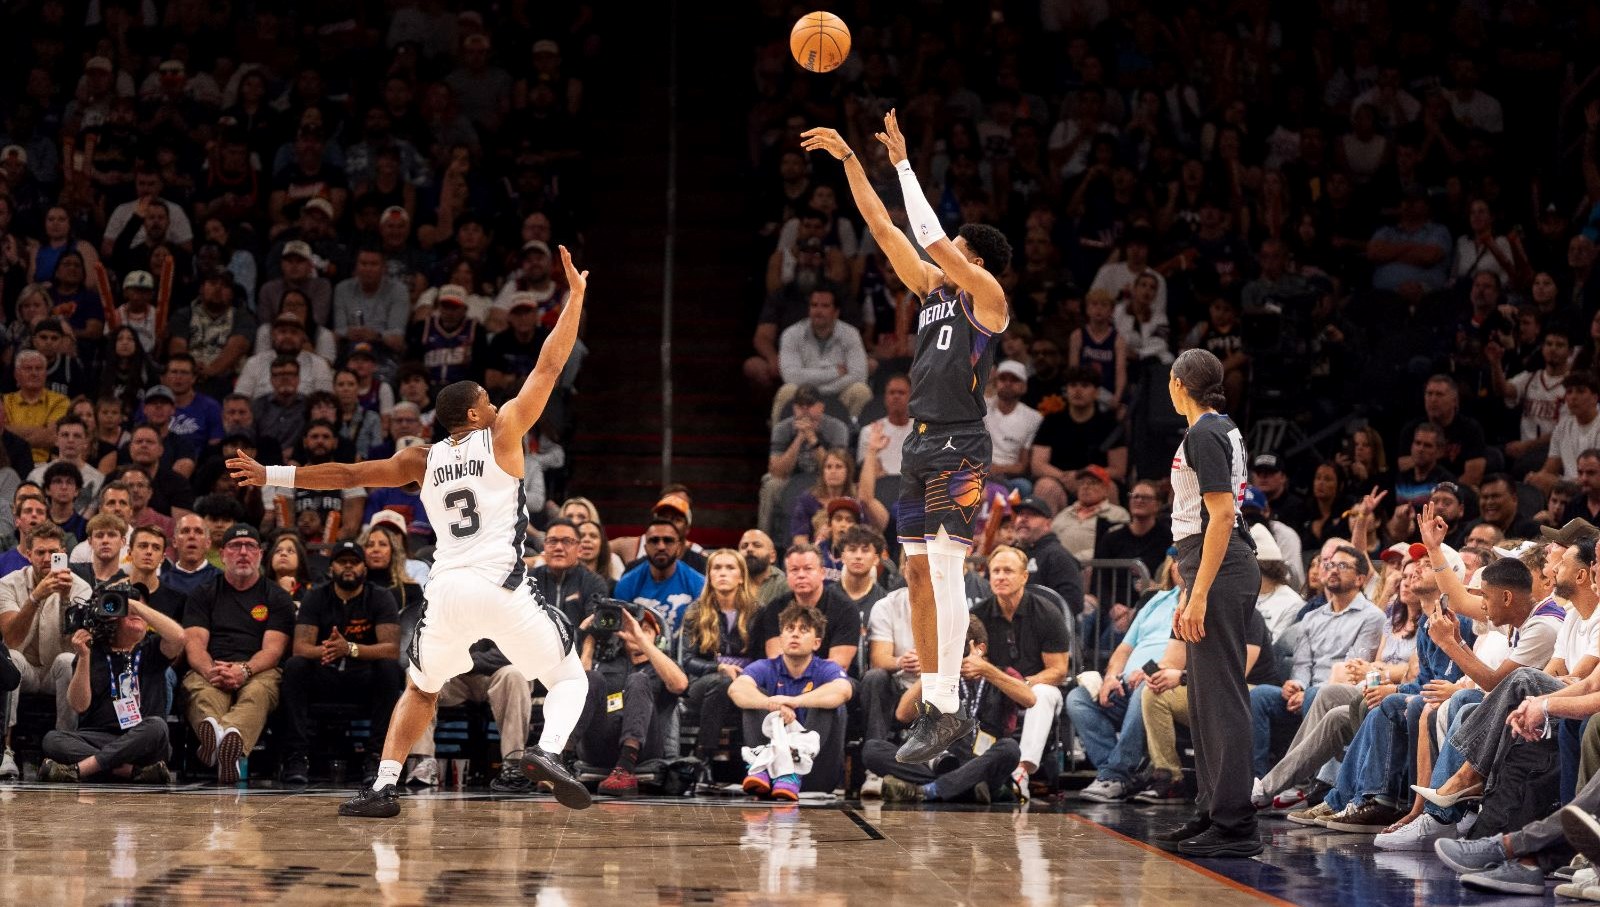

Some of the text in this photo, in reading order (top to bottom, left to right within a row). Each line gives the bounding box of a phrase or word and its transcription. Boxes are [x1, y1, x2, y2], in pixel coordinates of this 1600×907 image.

[936, 324, 953, 351] 0
[433, 459, 485, 487] JOHNSON
[443, 487, 482, 539] 3
